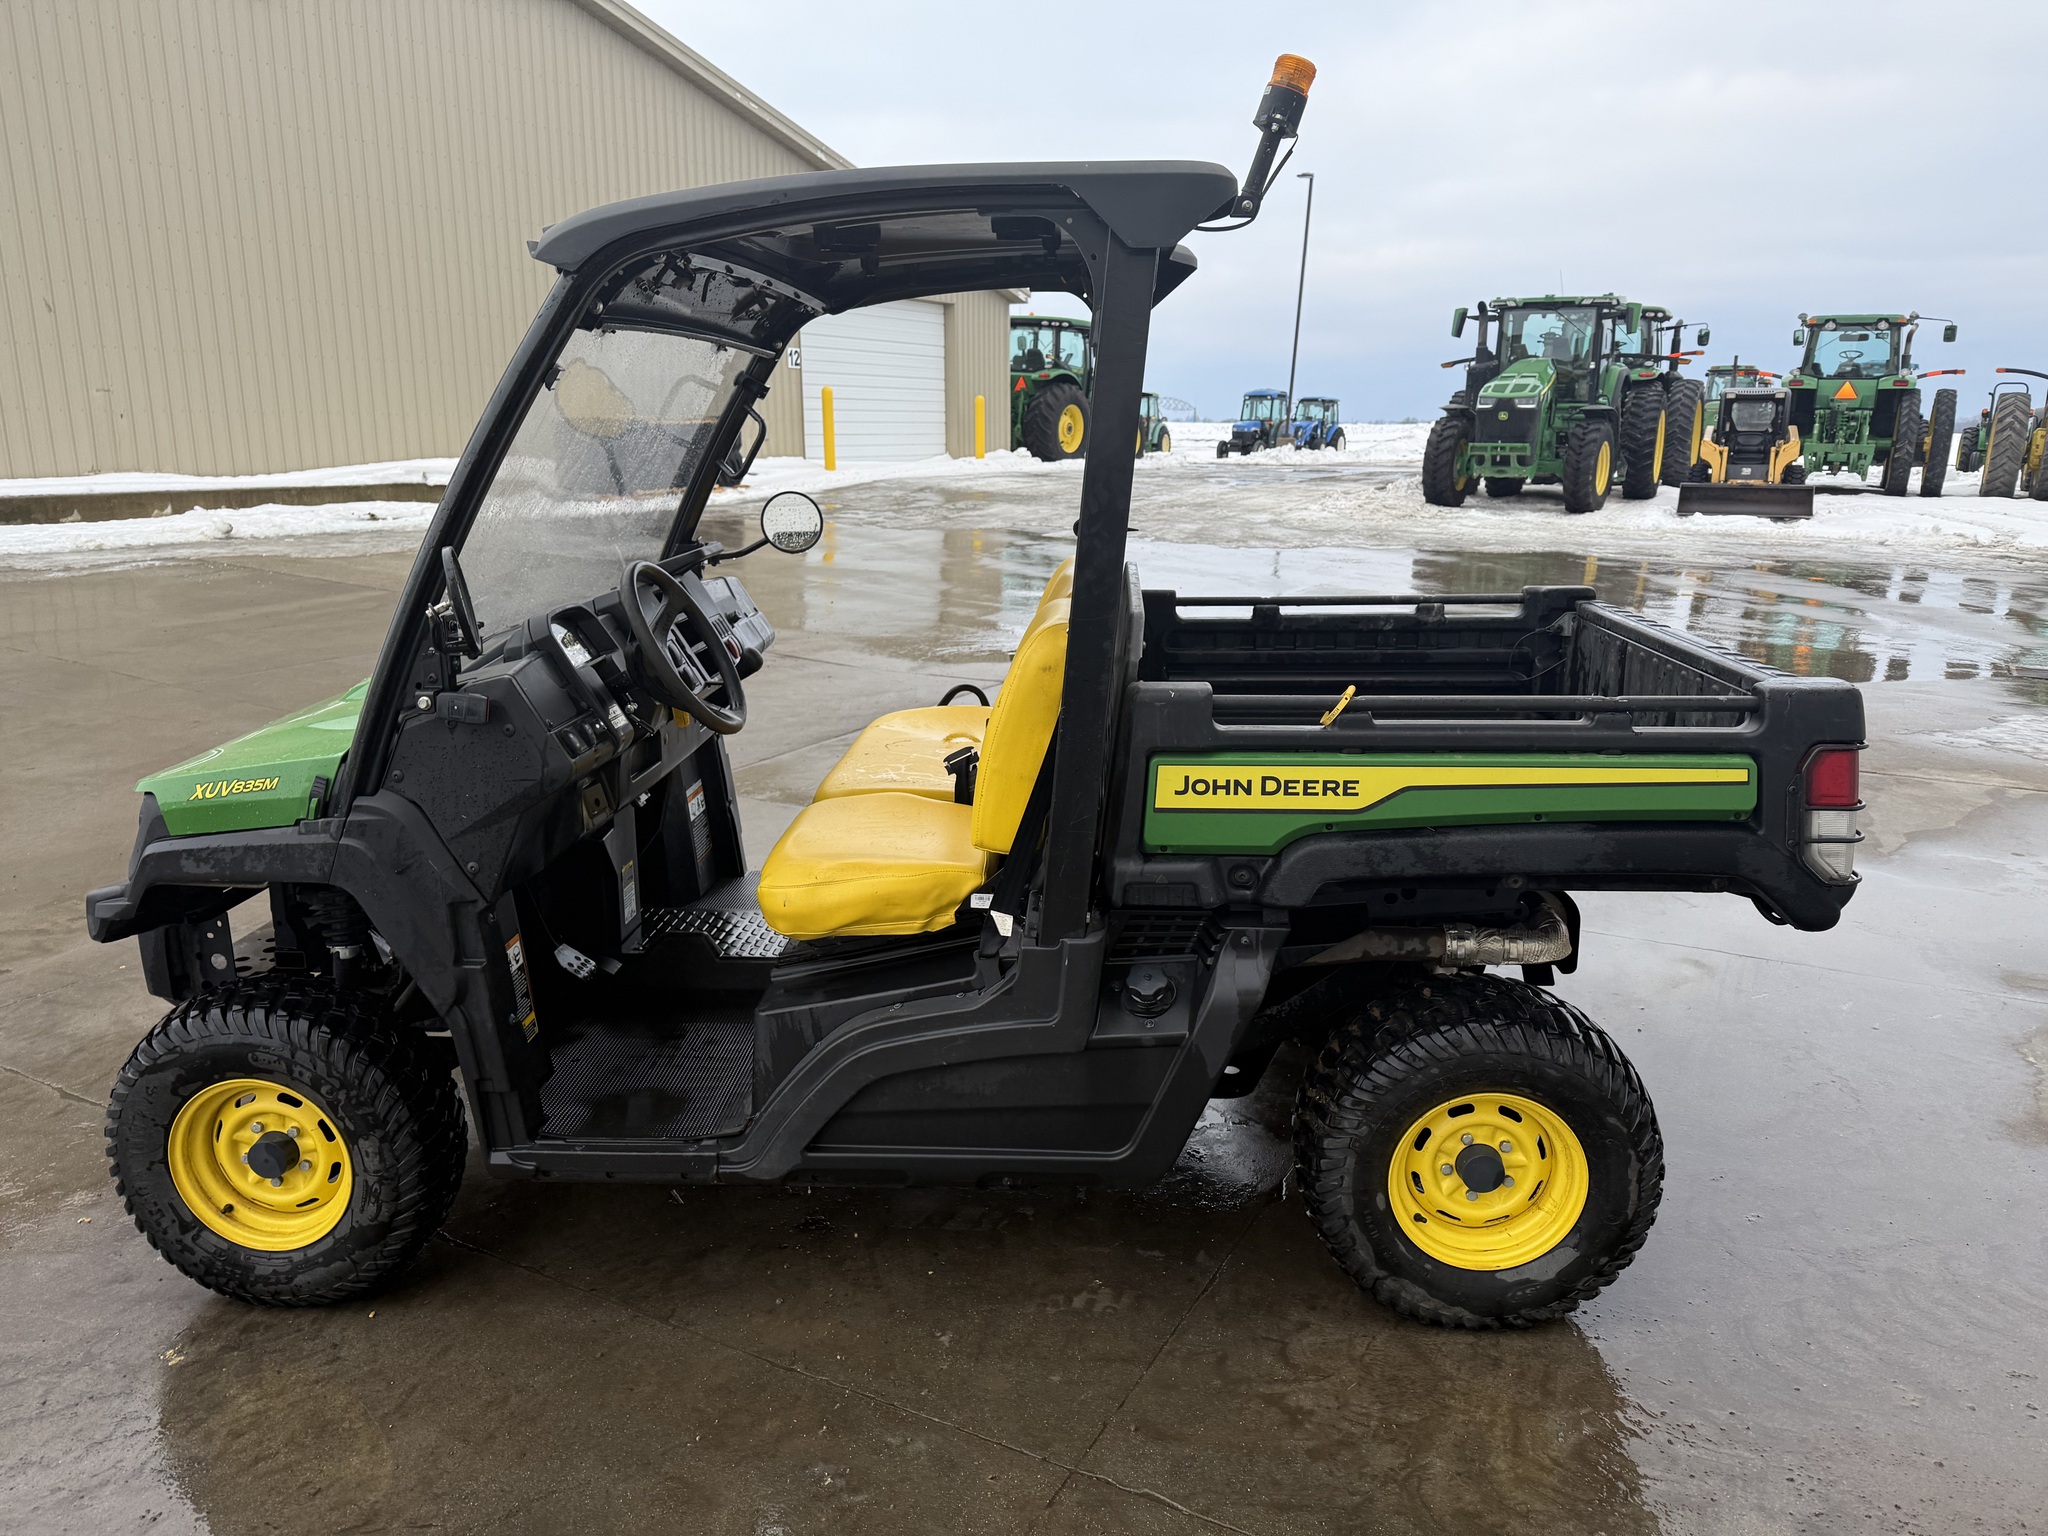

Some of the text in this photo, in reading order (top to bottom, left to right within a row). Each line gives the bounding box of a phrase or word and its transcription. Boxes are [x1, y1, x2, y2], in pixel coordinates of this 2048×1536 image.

[789, 349, 800, 367] 12
[187, 776, 280, 801] XUV835M
[1174, 775, 1360, 797] JOHN DEERE
